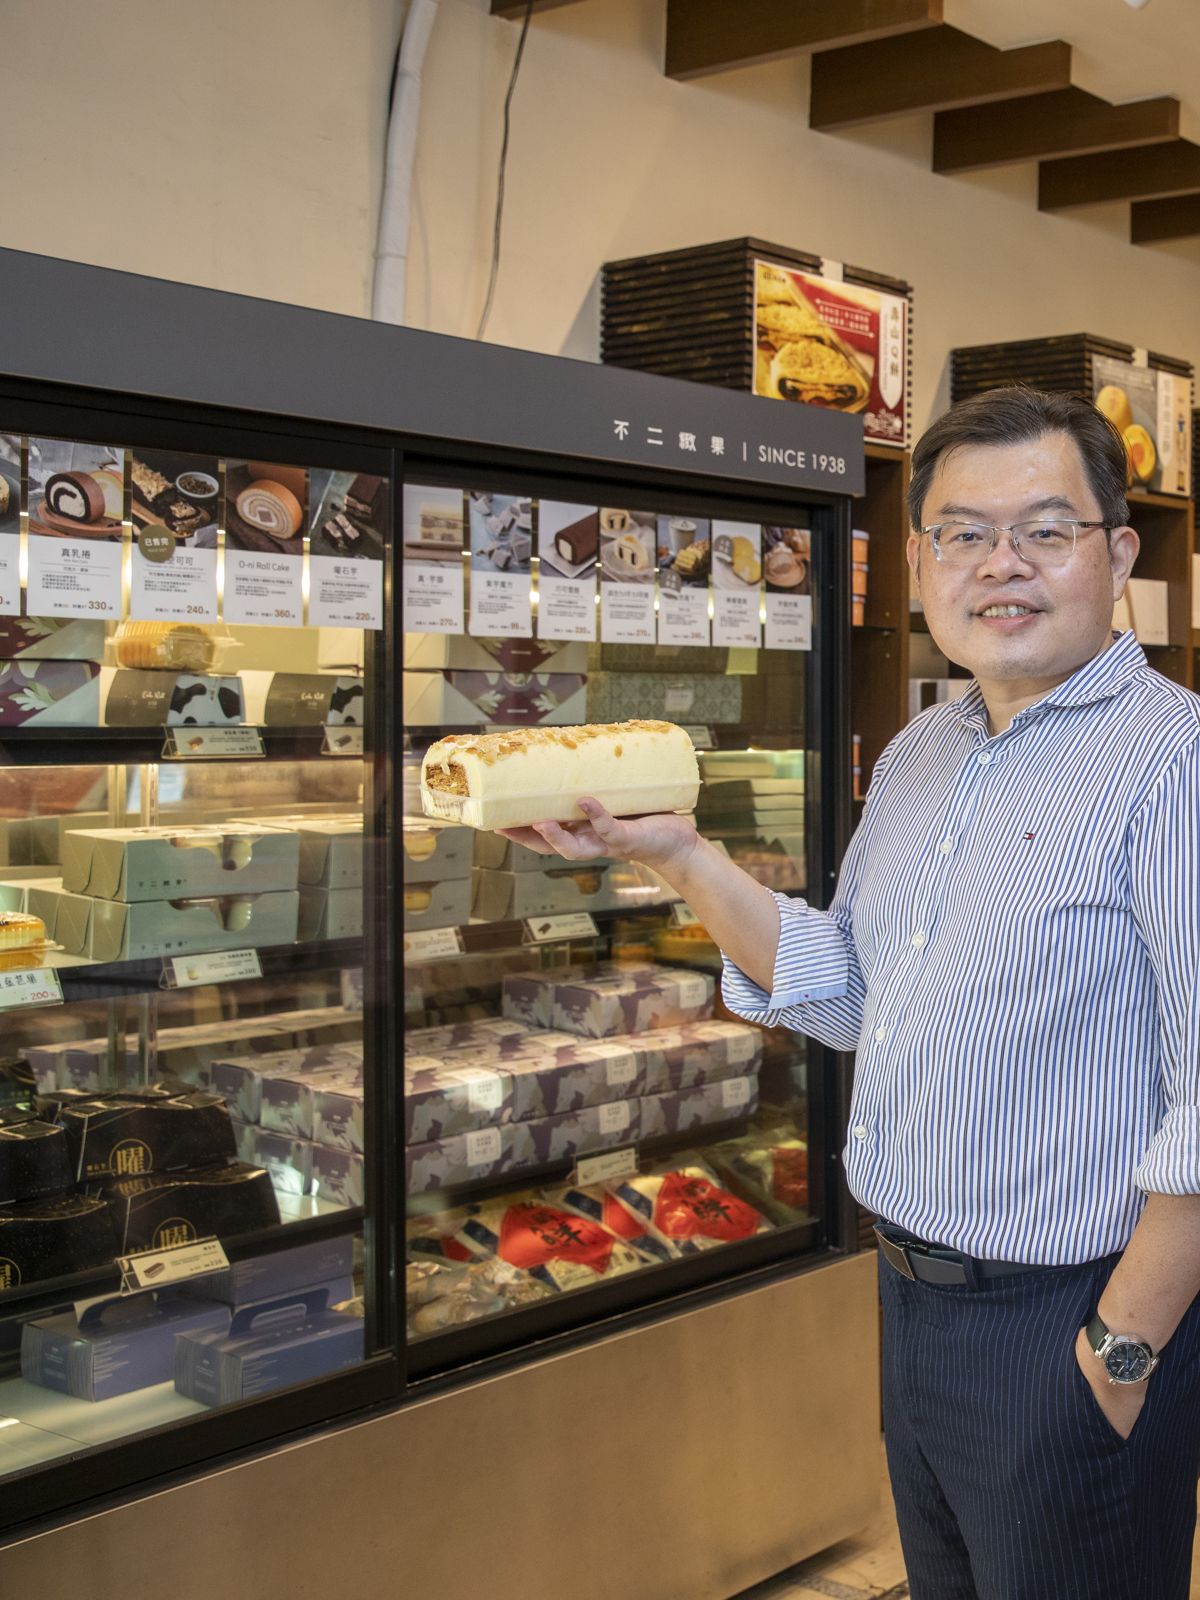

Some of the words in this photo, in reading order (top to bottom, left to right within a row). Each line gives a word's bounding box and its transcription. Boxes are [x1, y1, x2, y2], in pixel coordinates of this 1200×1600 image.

[758, 444, 806, 469] SINCE
[811, 453, 847, 475] 1938
[256, 561, 270, 570] Roll
[272, 563, 290, 572] Cake
[88, 600, 107, 610] 330
[186, 605, 204, 614] 240
[274, 609, 290, 618] 360
[355, 612, 371, 621] 220
[439, 618, 454, 627] 270
